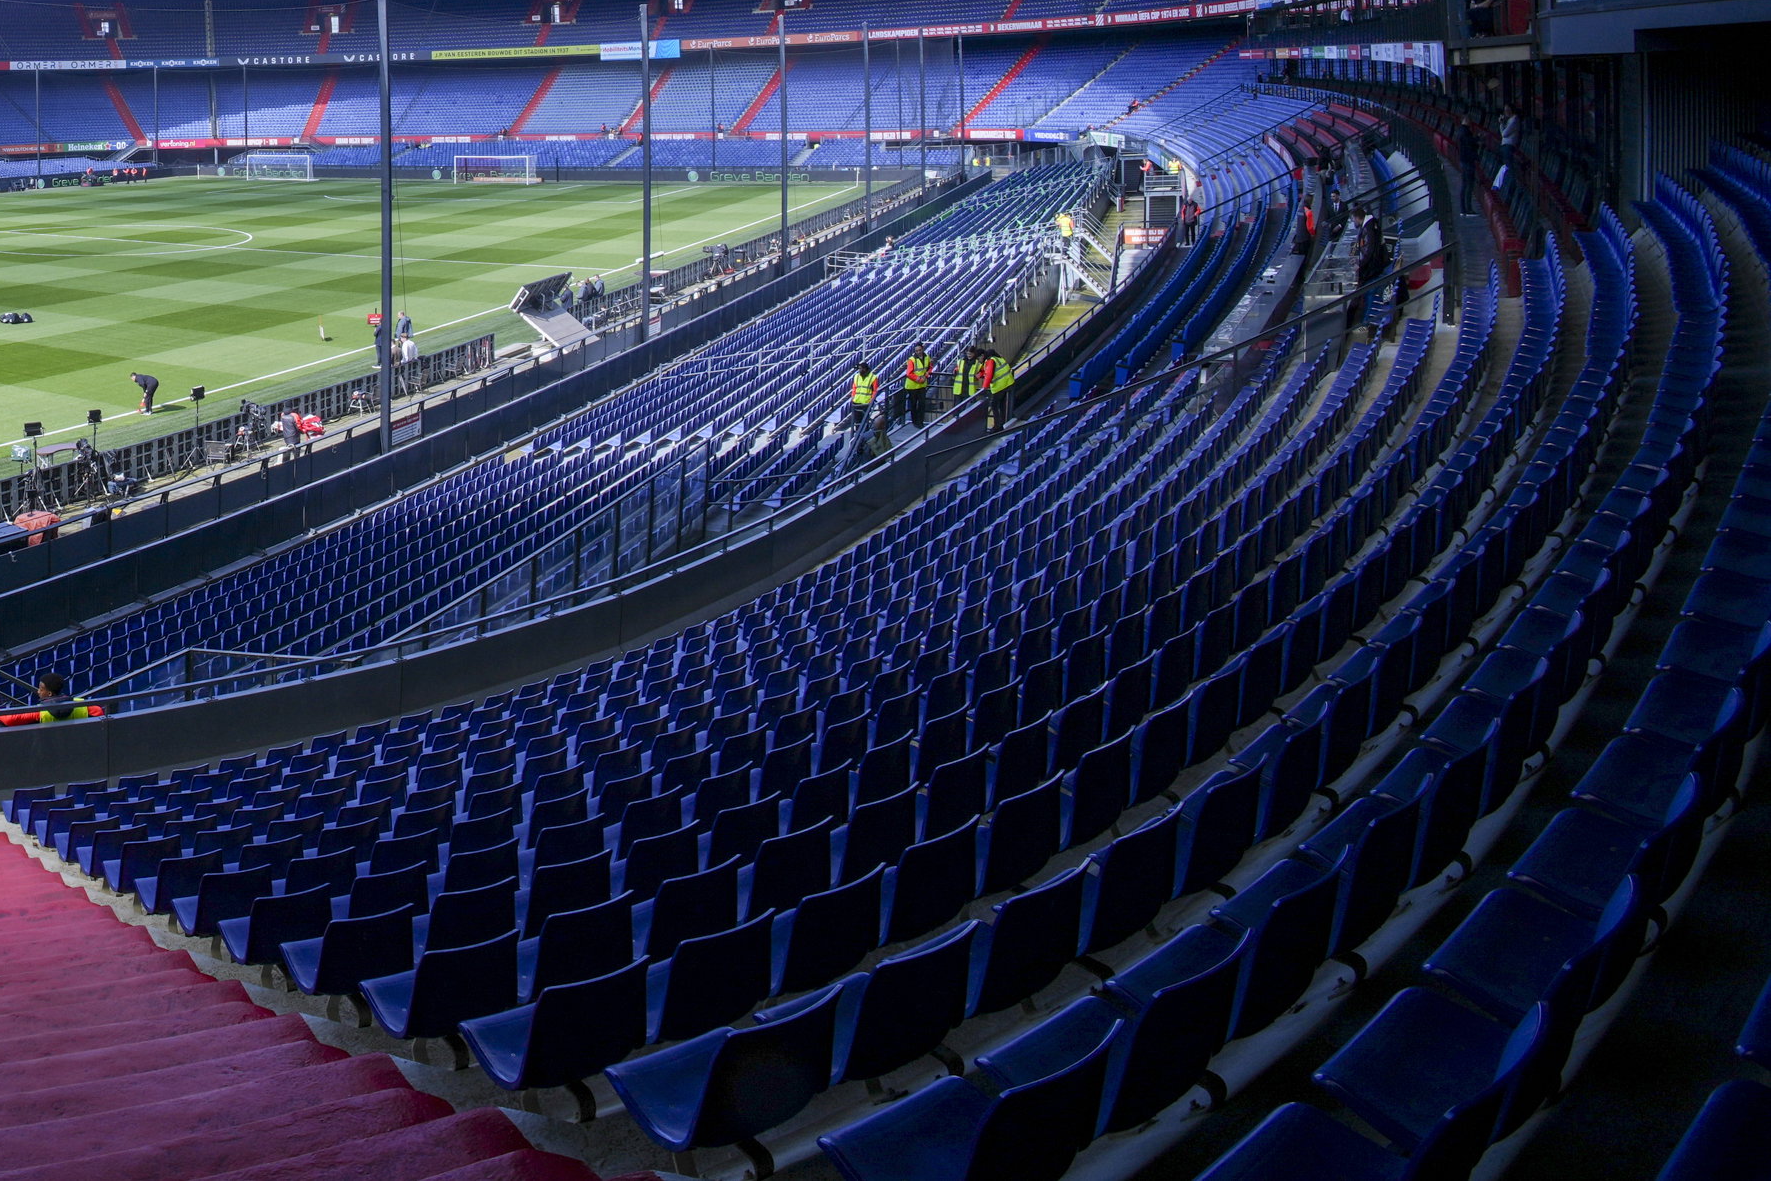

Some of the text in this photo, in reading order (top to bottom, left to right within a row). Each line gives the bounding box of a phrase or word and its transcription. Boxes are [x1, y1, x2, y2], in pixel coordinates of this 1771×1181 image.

[1115, 13, 1138, 22] WINNAAR
[1138, 12, 1150, 20] UEFA
[1151, 10, 1160, 19] CUP
[1161, 9, 1172, 18] 1974
[1178, 8, 1190, 17] 2002
[815, 33, 850, 42] EuroParcs
[868, 28, 918, 39] LANDSKAMPIOEN
[523, 48, 548, 56] STADION
[254, 52, 415, 65] CASTORE CASORE
[68, 143, 104, 151] Heineken
[233, 168, 305, 178] Greve Banden
[710, 171, 750, 182] Greve
[52, 177, 79, 187] Greve
